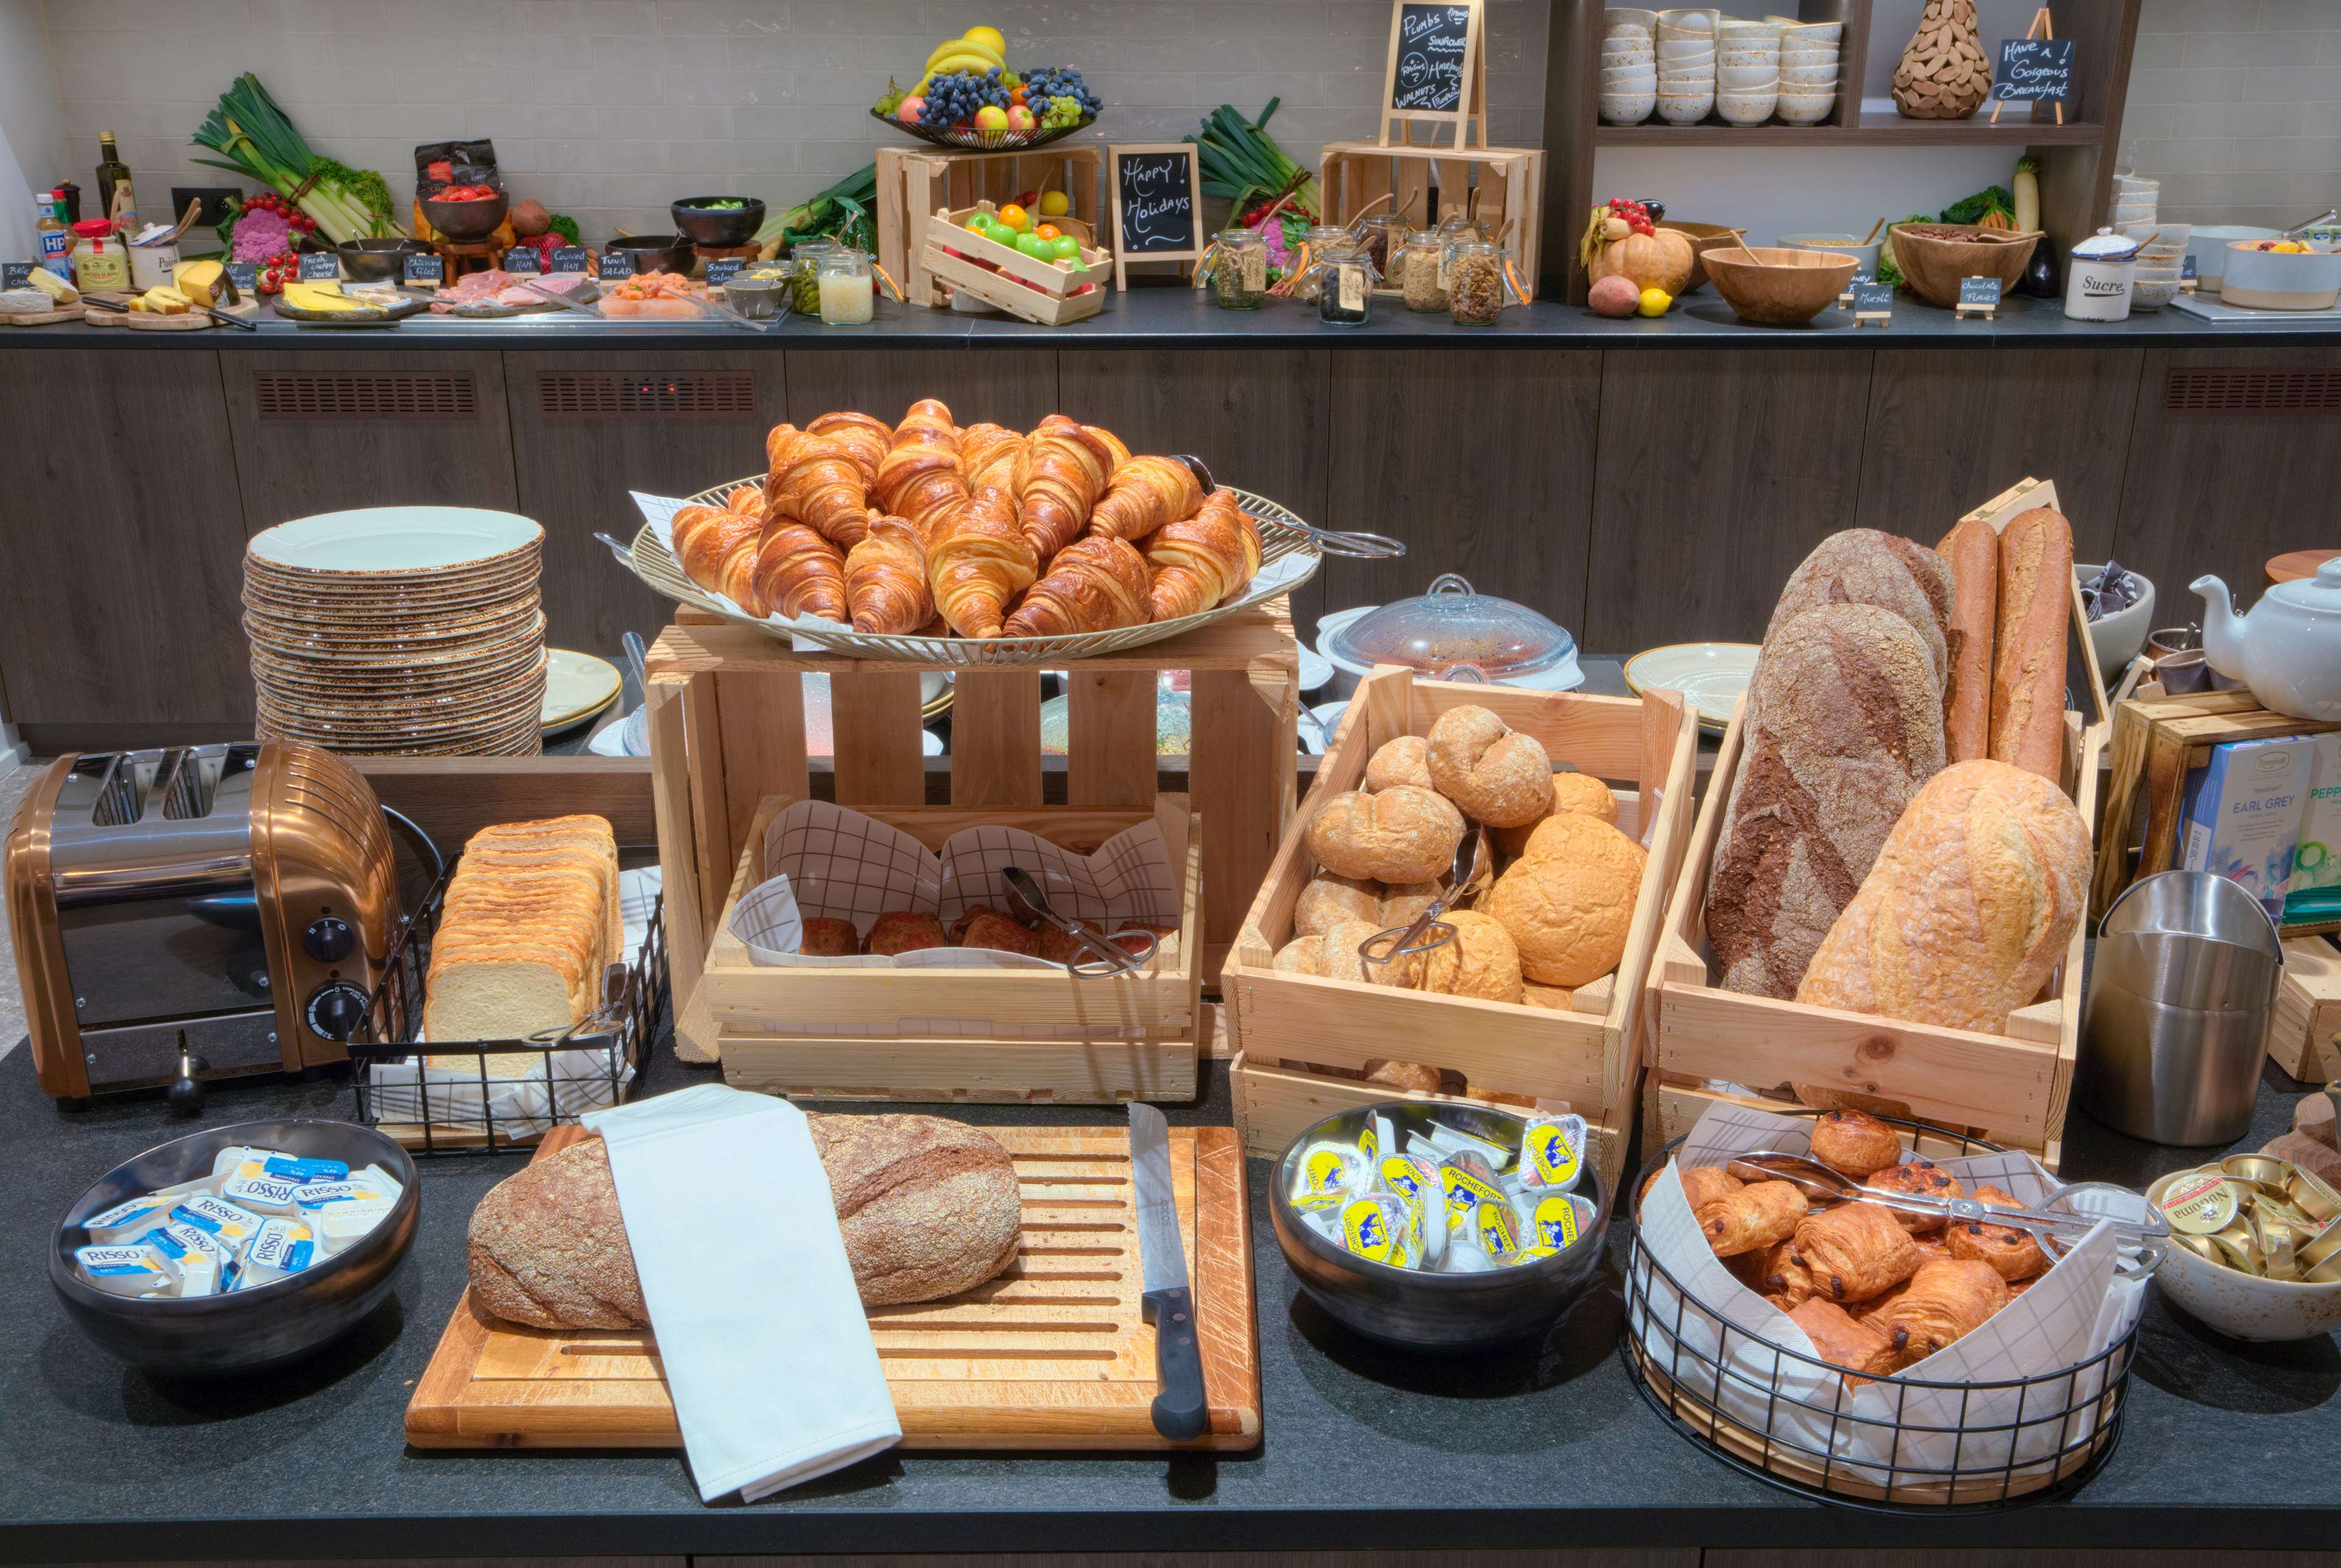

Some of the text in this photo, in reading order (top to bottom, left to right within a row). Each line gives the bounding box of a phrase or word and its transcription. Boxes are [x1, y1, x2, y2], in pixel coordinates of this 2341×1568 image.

[45, 237, 65, 251] HP
[600, 256, 625, 265] TUNA
[2083, 276, 2125, 295] Sucre
[2233, 795, 2295, 813] EARL GREY
